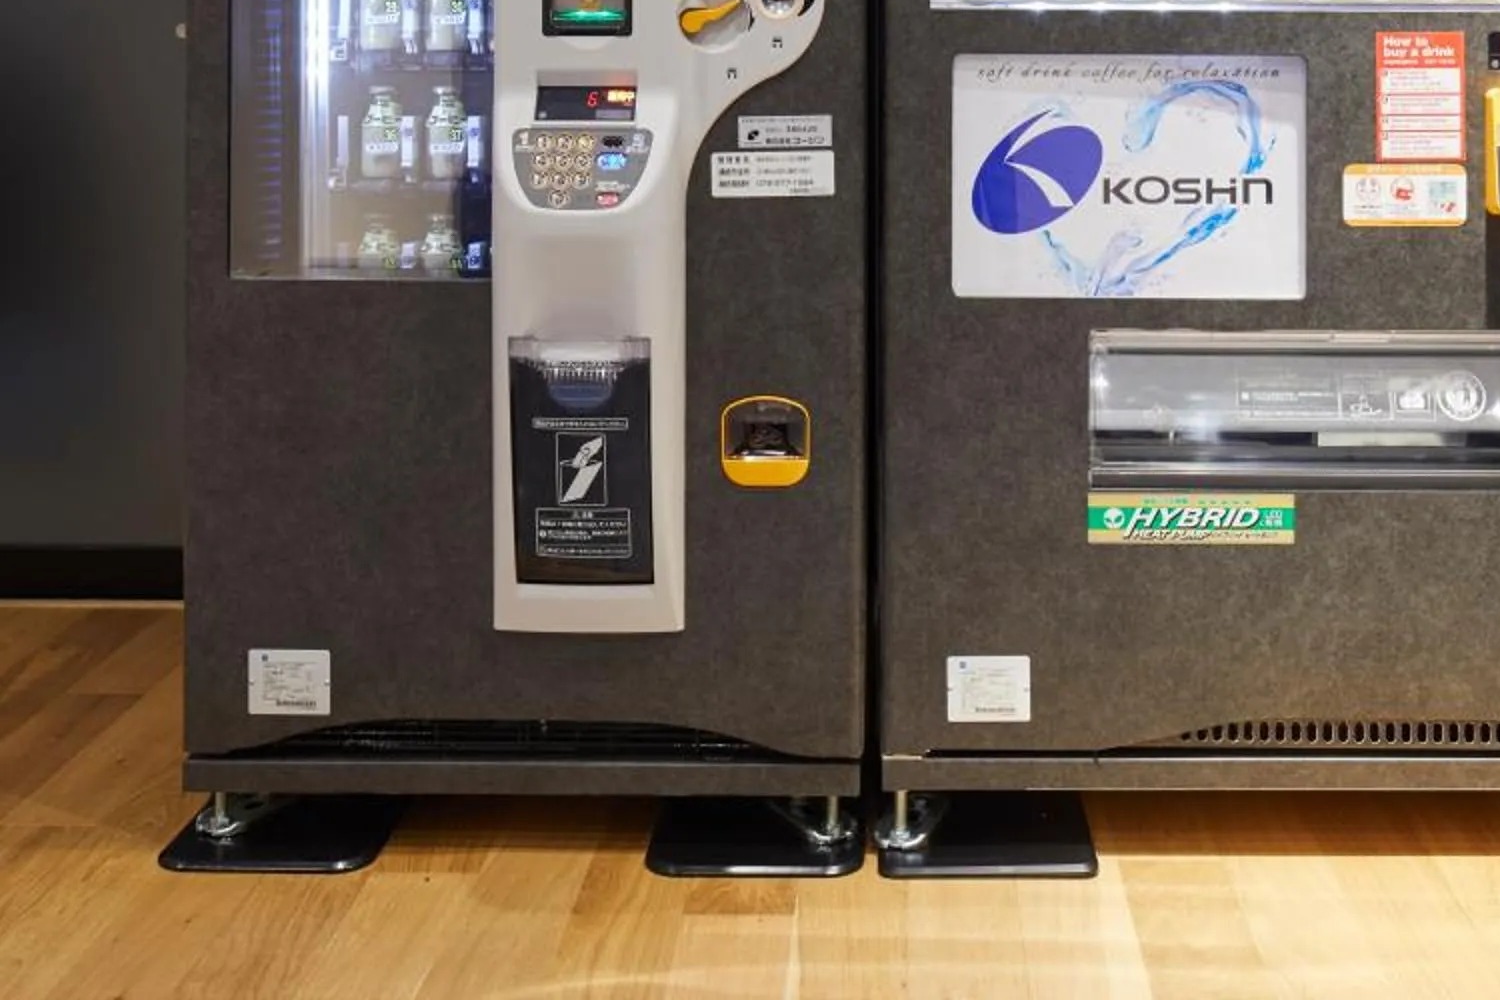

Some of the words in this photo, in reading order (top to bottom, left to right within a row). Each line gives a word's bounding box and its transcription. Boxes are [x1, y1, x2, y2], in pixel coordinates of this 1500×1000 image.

[1383, 36, 1411, 47] How
[1415, 36, 1429, 47] to
[1383, 47, 1408, 58] buy
[1422, 46, 1455, 57] drink
[977, 64, 1013, 85] soft
[1020, 62, 1075, 79] drink
[1081, 63, 1138, 84] coffee
[1142, 62, 1174, 86] for
[1181, 62, 1281, 79] relaxation
[1102, 176, 1274, 205] KOSHIN
[1124, 508, 1261, 540] HYBRID
